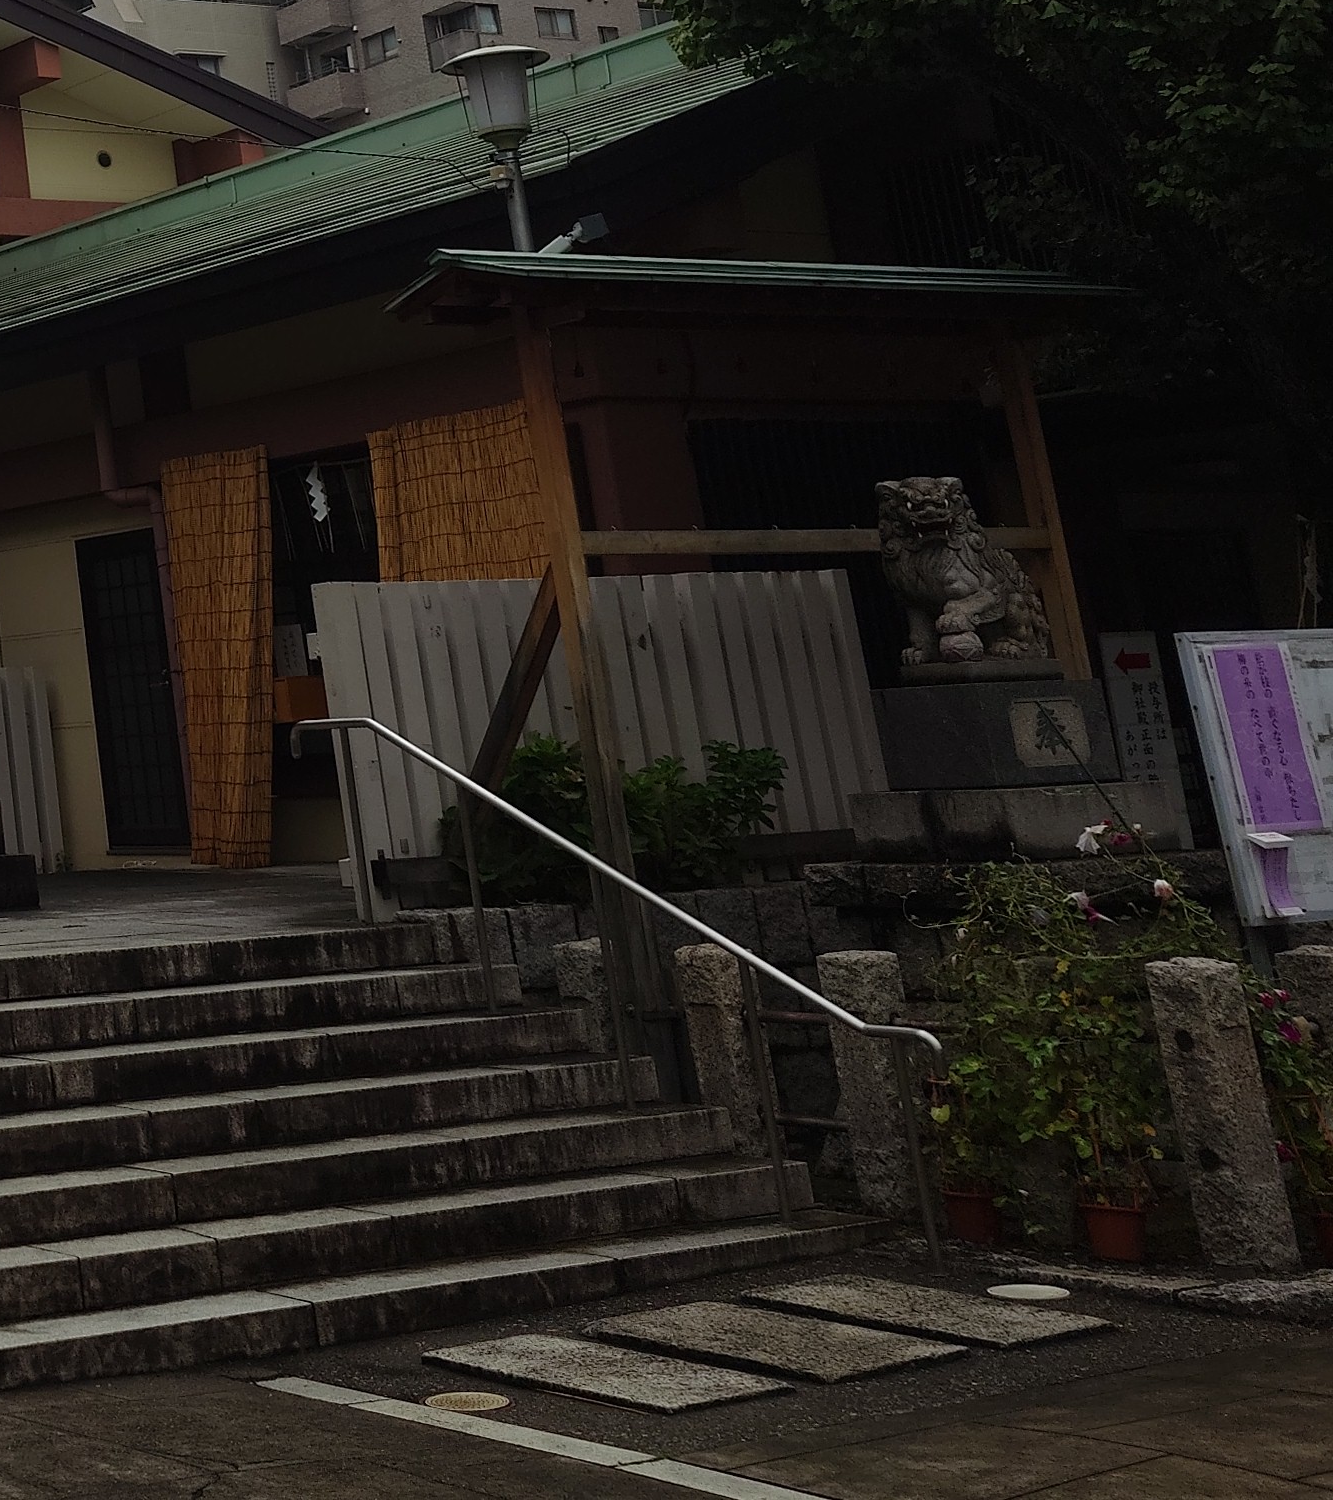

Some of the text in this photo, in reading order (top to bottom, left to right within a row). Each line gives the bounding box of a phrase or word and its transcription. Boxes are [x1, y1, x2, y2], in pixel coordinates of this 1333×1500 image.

[1035, 707, 1073, 755] 奉
[1148, 681, 1167, 740] 授与所は
